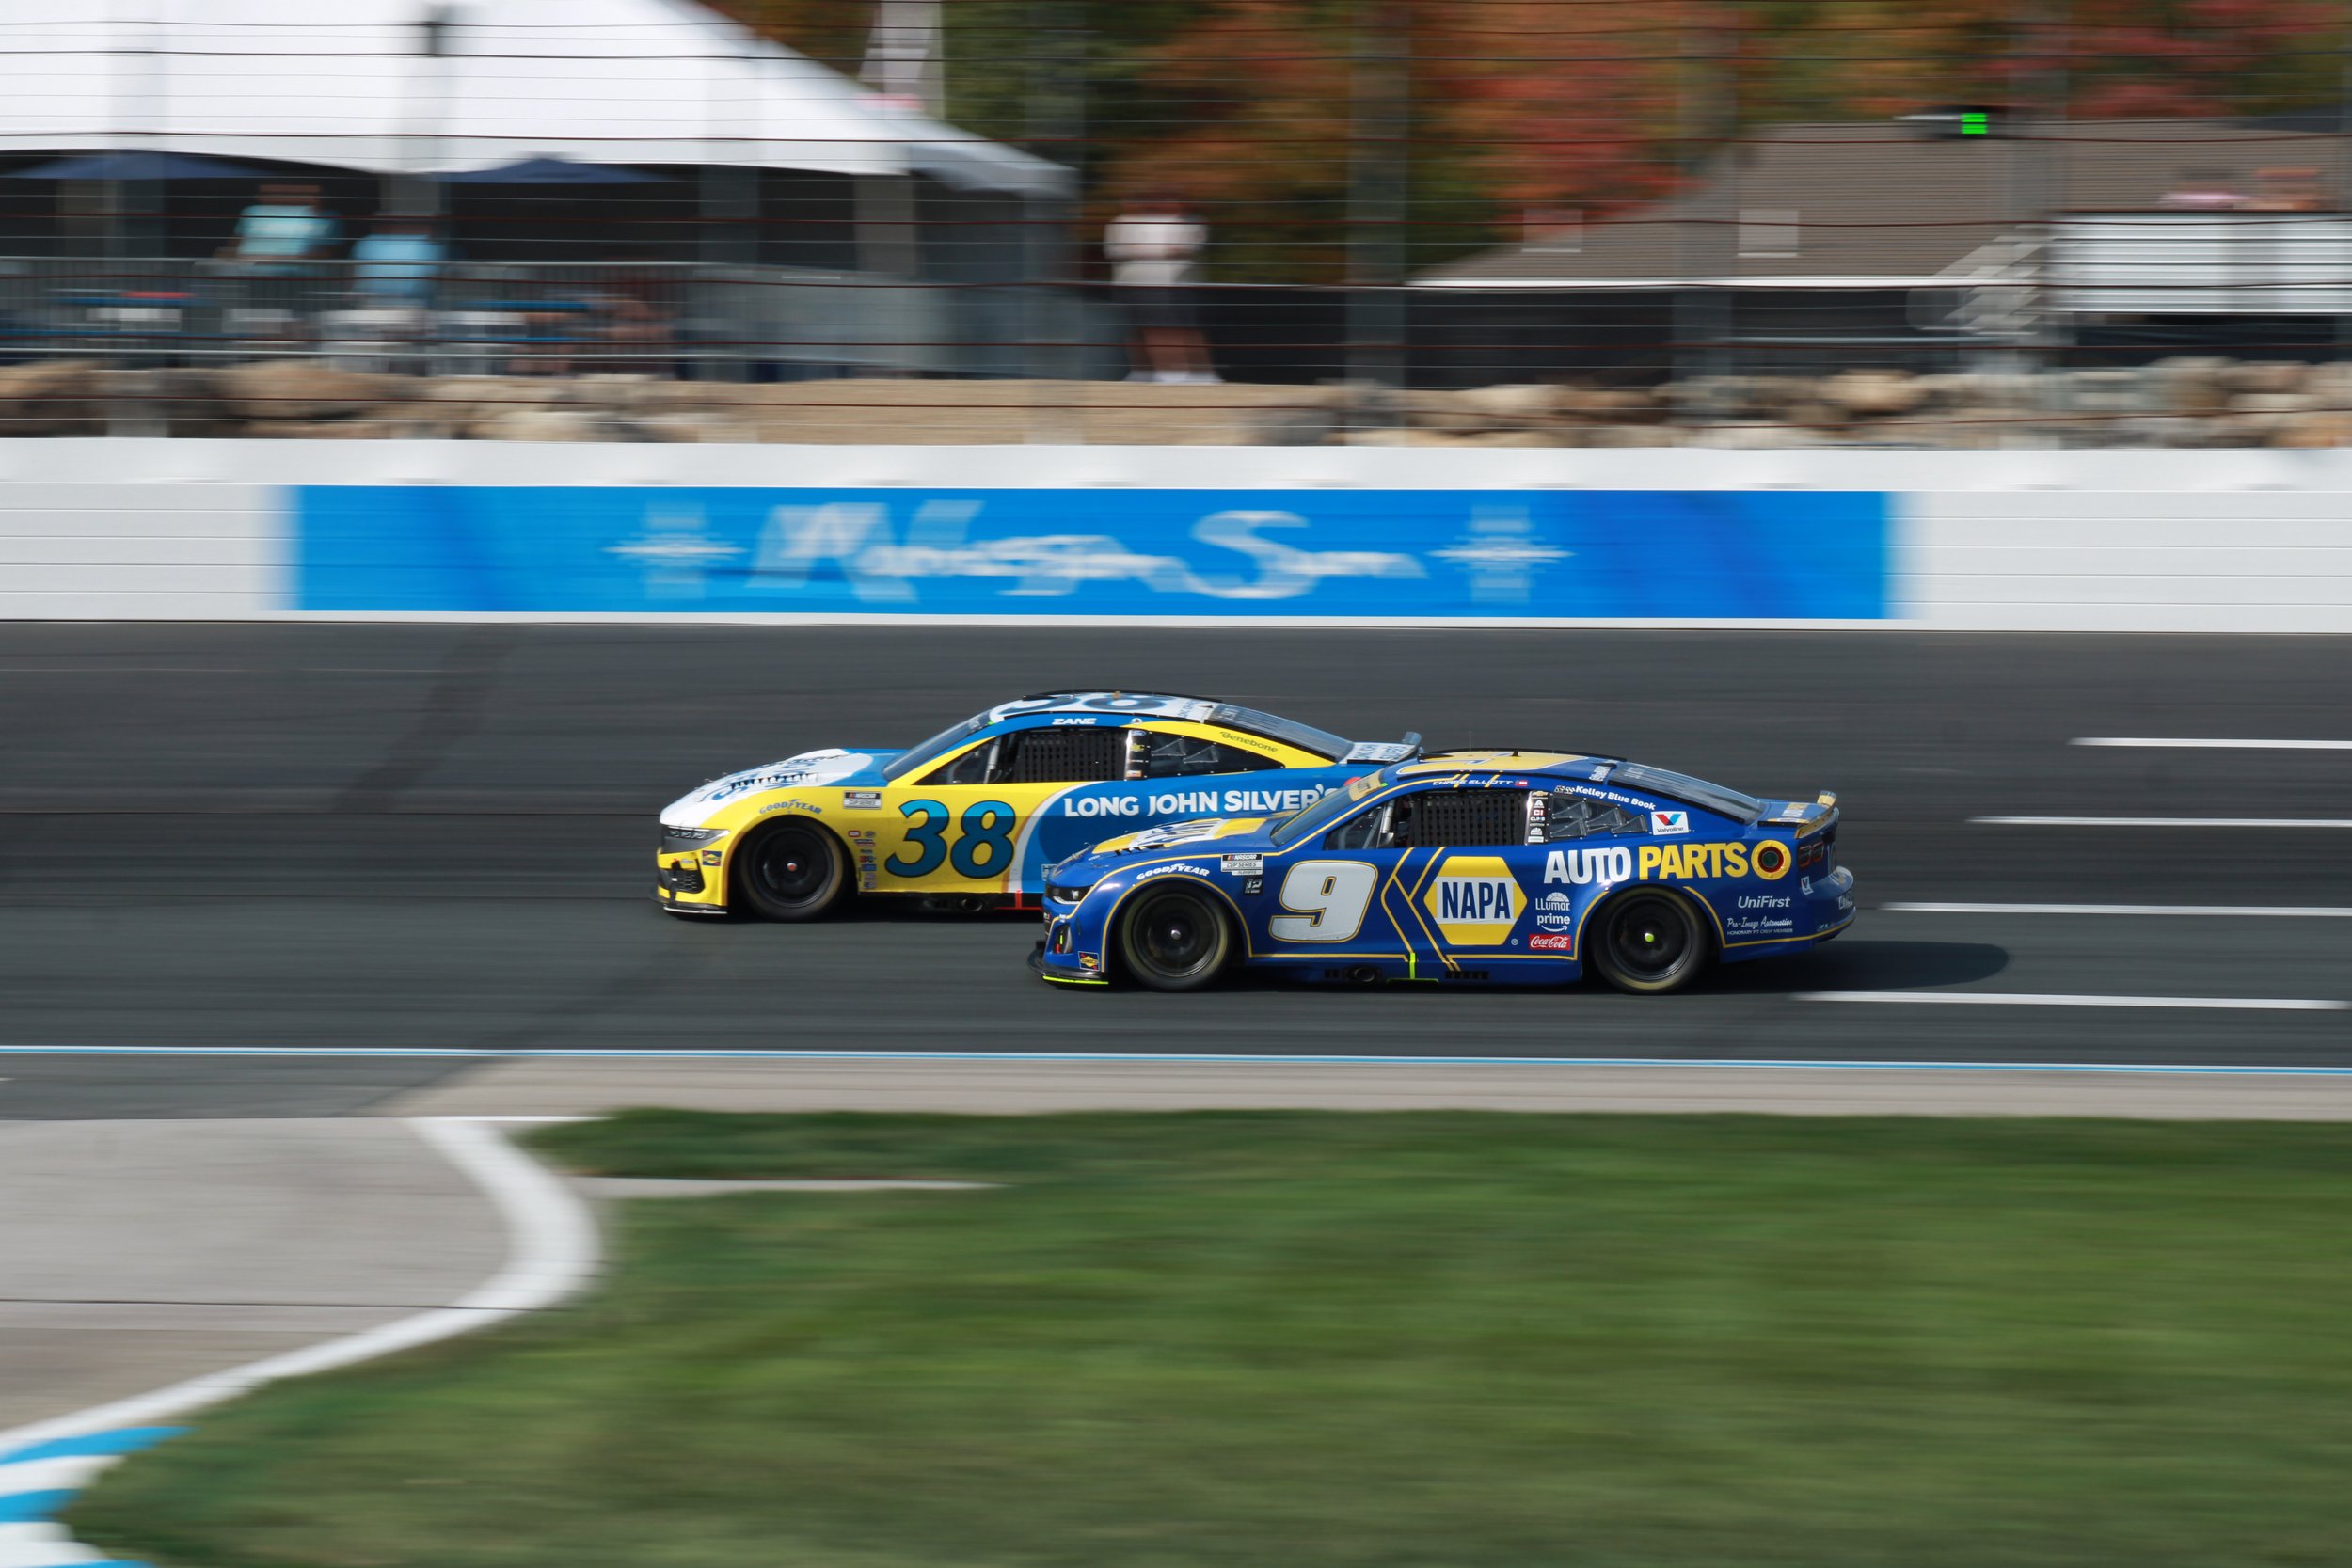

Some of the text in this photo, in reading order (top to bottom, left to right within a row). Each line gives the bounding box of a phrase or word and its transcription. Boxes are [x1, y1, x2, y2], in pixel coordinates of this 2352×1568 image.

[1220, 731, 1278, 752] Benebone
[759, 799, 822, 815] GOODYEAR
[1064, 796, 1139, 817] LONG
[1148, 791, 1217, 816] JOHN
[1575, 785, 1607, 799] Kelley
[1607, 792, 1629, 803] Blue
[1630, 799, 1656, 810] Book
[884, 799, 1016, 879] 38
[1136, 863, 1210, 880] GOODYEAR
[1544, 842, 1749, 884] AUTO PARTS
[1268, 859, 1379, 943] 9
[1442, 881, 1511, 919] NAPA
[1738, 895, 1791, 909] UniFirst
[1537, 913, 1571, 926] prime
[1760, 916, 1793, 927] Automotive
[1530, 935, 1569, 948] Coca-Cola
